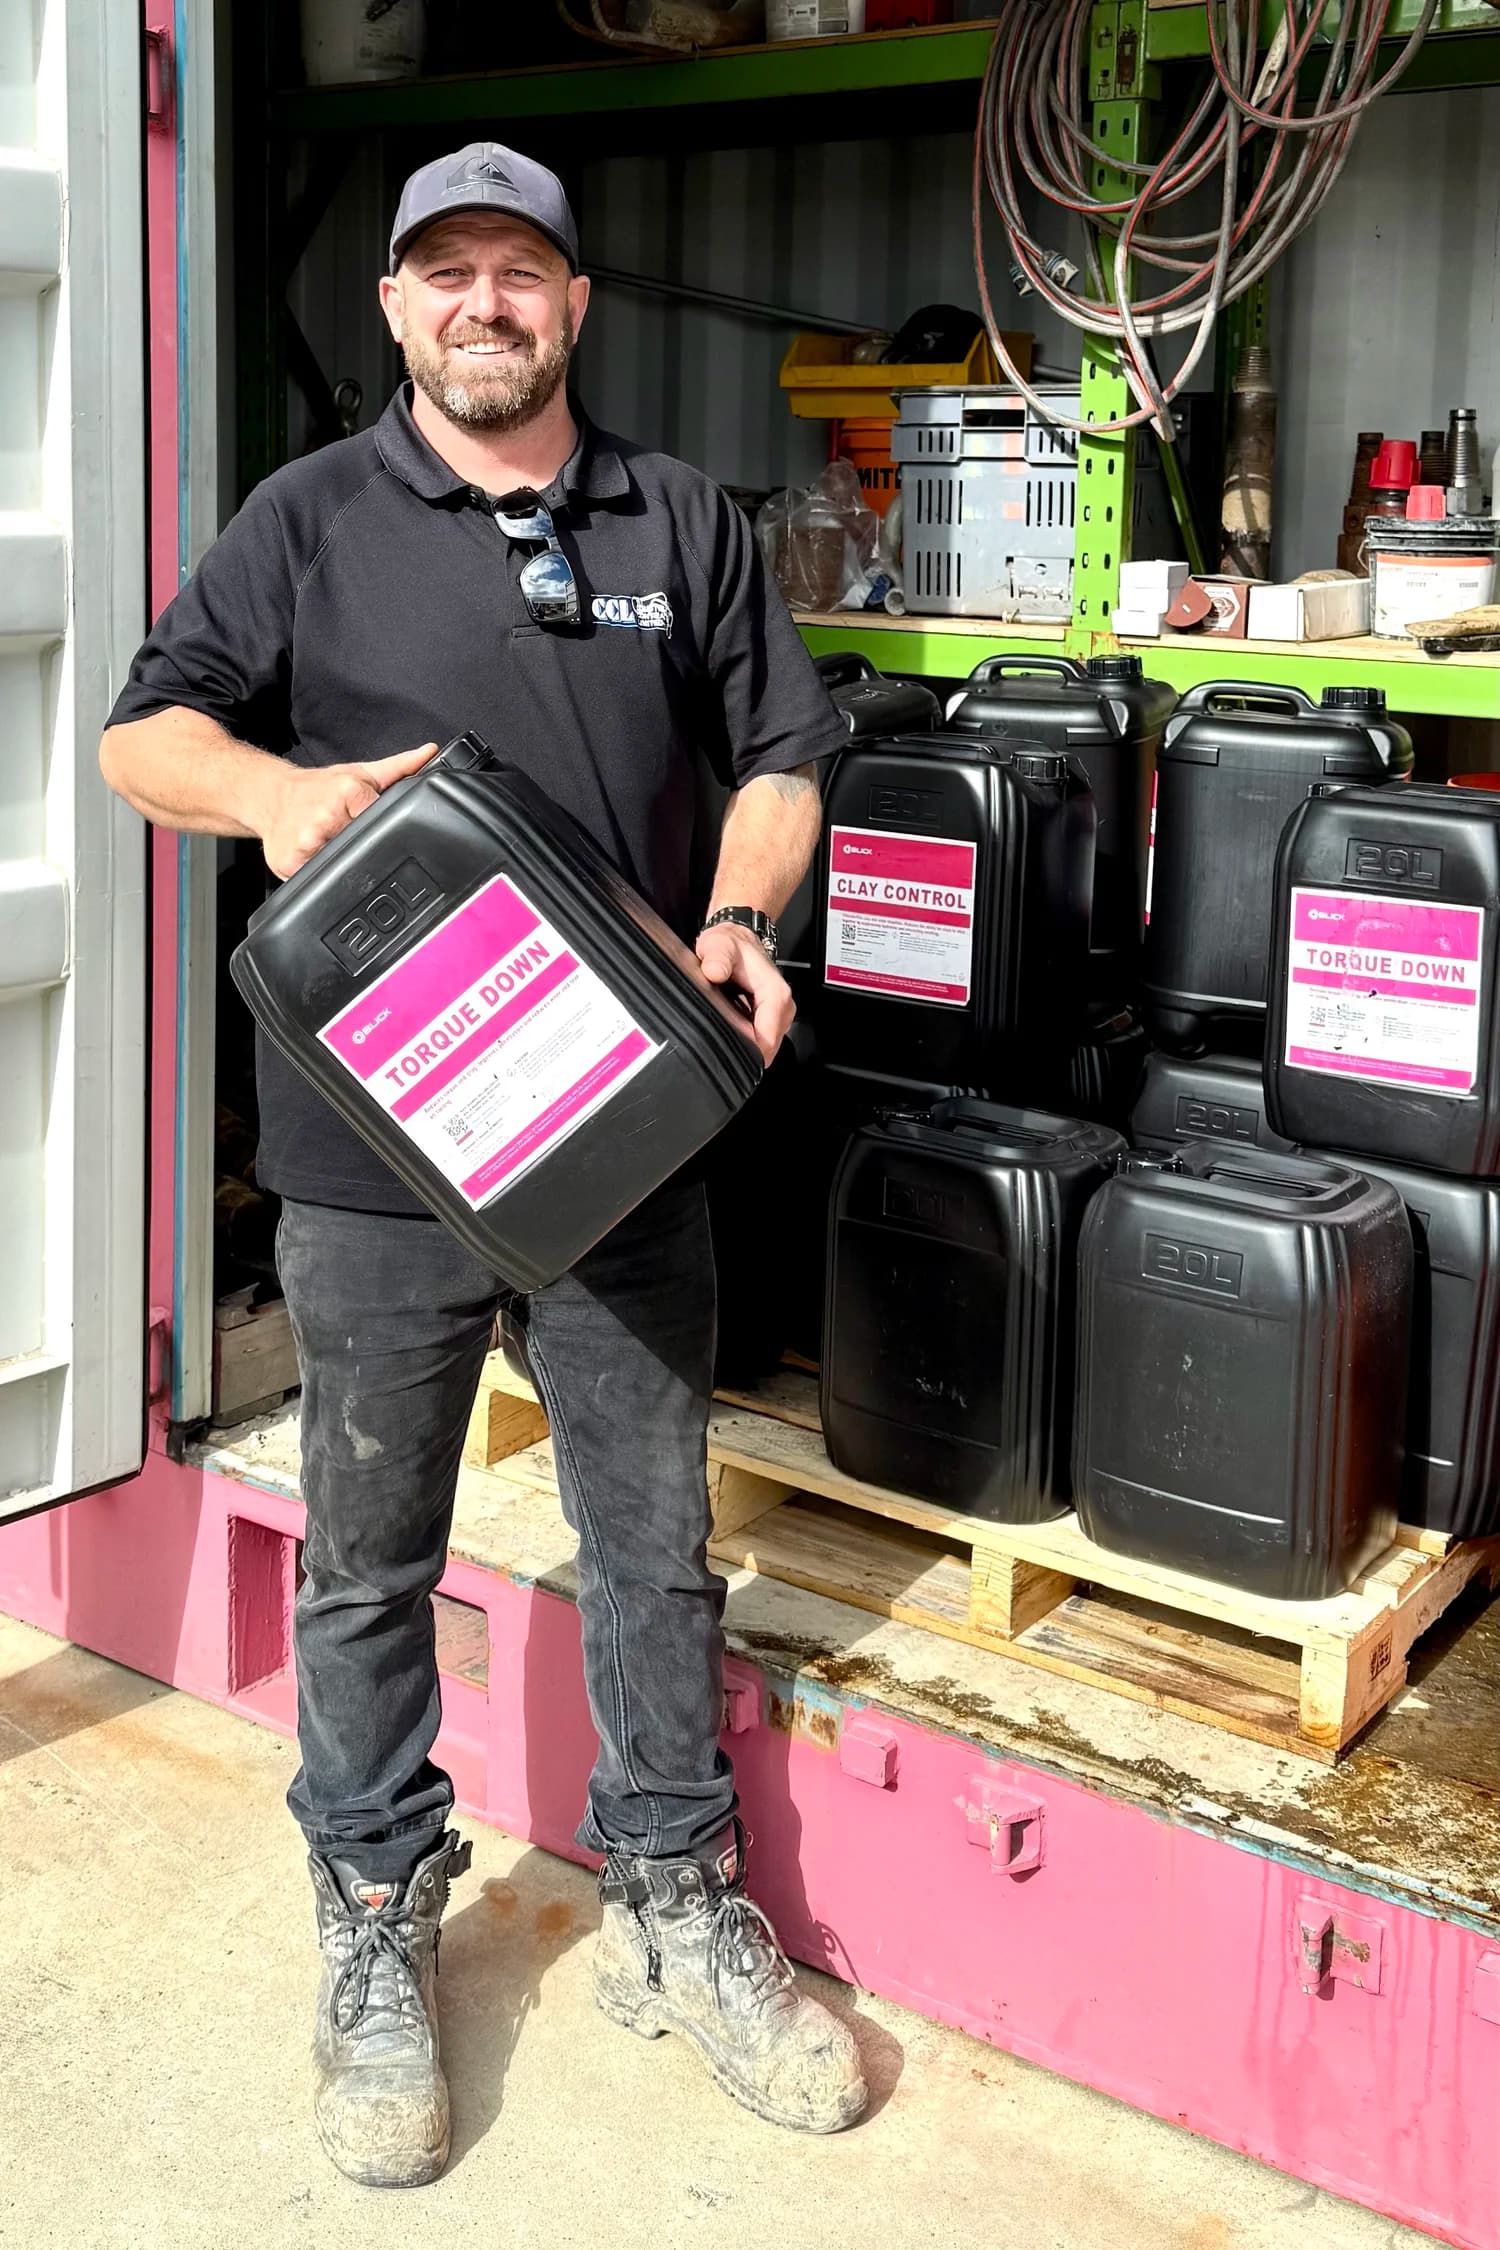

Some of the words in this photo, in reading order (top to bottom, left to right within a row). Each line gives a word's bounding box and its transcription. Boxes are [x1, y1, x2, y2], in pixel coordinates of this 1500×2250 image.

[592, 598, 635, 624] CCL
[1357, 846, 1434, 880] 20L
[837, 878, 878, 897] CLAY
[884, 885, 967, 909] CONTROL
[338, 881, 433, 961] 20L
[1306, 948, 1393, 974] TORQUE
[1401, 960, 1466, 983] DOWN
[362, 1008, 392, 1036] BLICK
[385, 1002, 481, 1088] TORQUE
[478, 940, 550, 1007] DOWN
[1185, 1104, 1250, 1138] 20L
[1155, 1243, 1233, 1287] 20L
